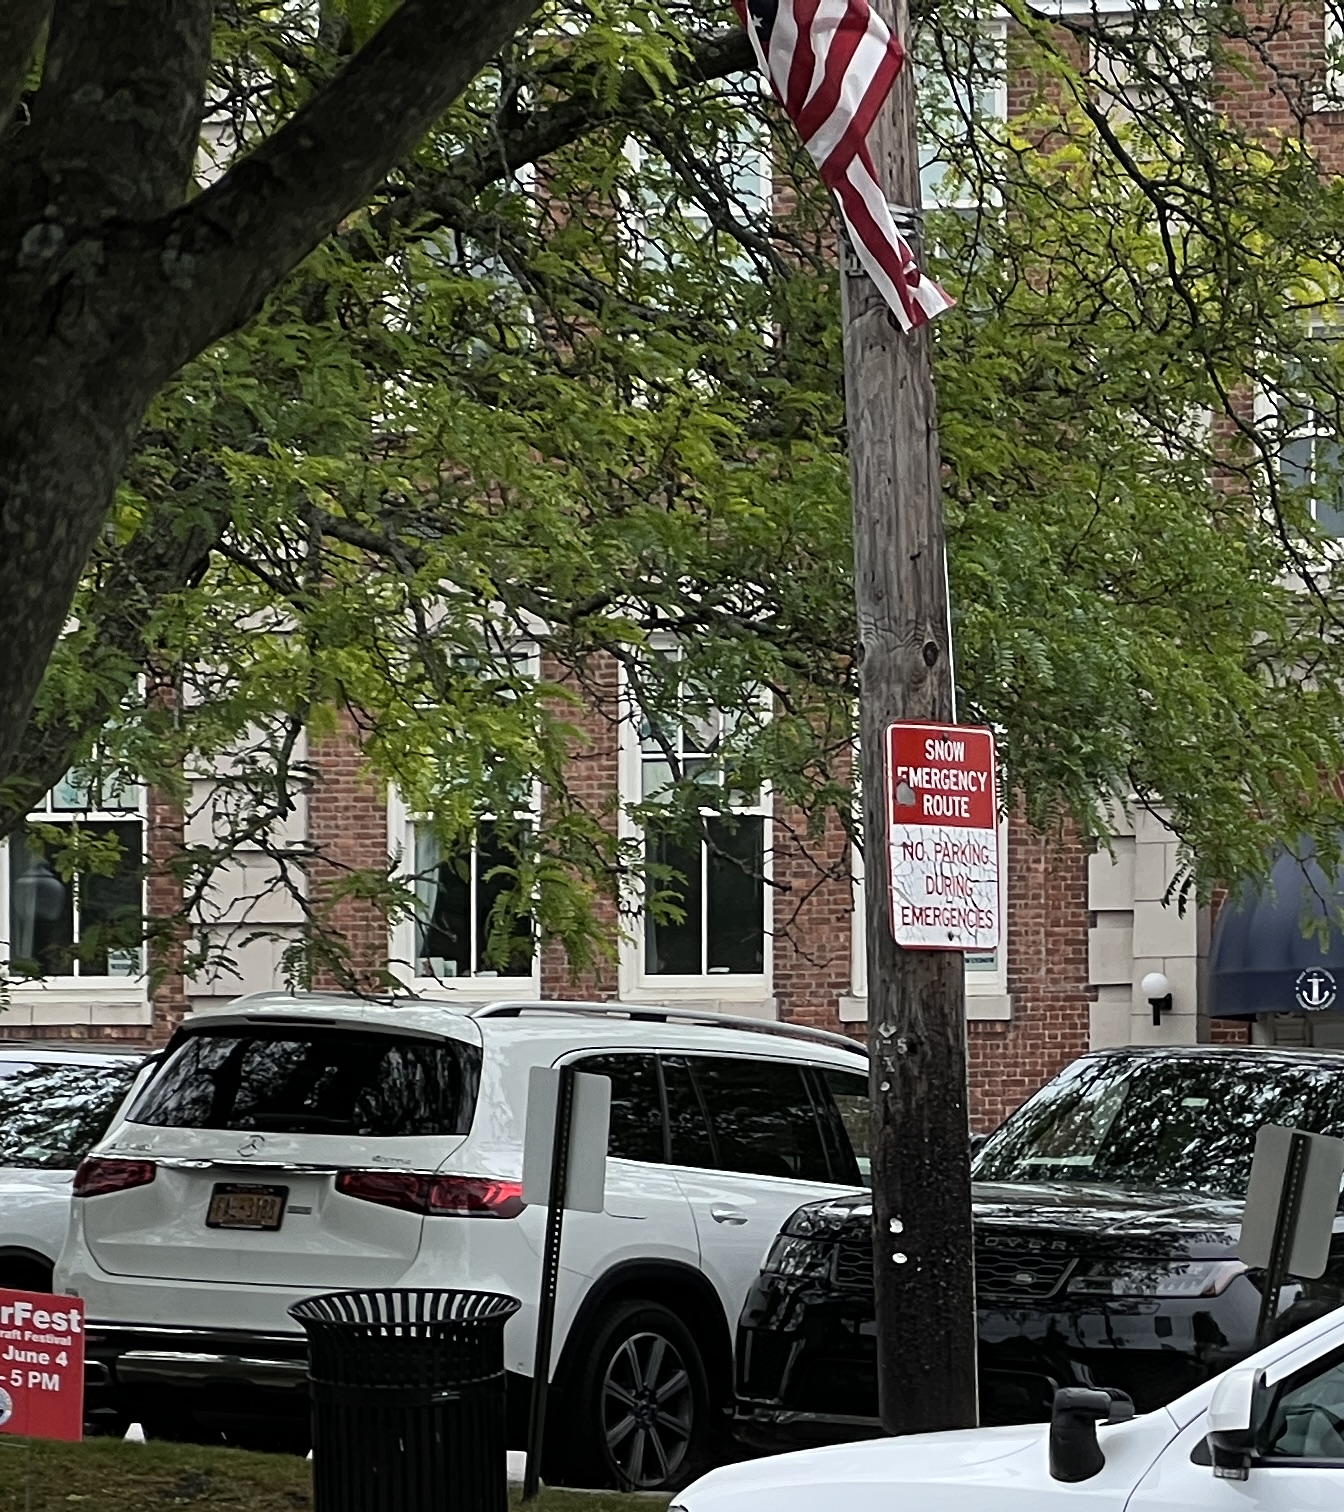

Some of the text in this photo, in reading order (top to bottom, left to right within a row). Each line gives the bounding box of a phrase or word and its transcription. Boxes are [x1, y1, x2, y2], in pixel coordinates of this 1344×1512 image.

[925, 739, 965, 762] SNOW
[897, 766, 988, 792] EMERGENCY
[923, 795, 970, 818] ROUTE
[902, 841, 924, 861] NO
[934, 841, 989, 864] PARKING
[926, 875, 973, 897] DURING
[901, 906, 994, 929] EMERGENCIES
[24, 1330, 72, 1346] Festival
[2, 1345, 68, 1367] June 4
[10, 1369, 23, 1387] 5
[28, 1371, 60, 1392] PM
